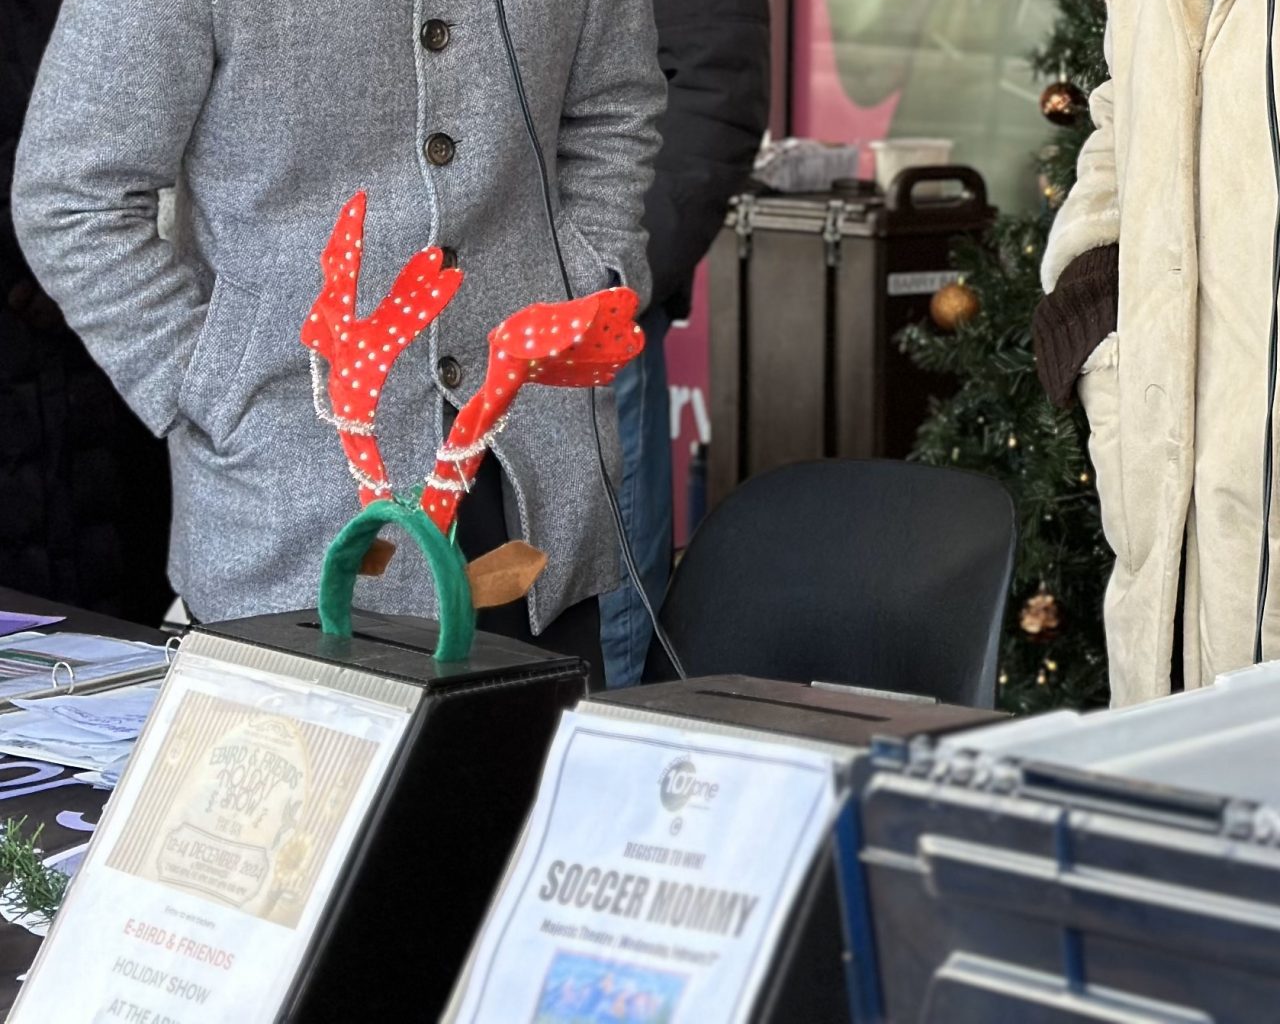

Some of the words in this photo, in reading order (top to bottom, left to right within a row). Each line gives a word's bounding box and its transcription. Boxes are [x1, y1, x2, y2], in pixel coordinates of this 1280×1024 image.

[623, 841, 669, 867] REGISTER
[538, 859, 650, 920] SOCCER
[645, 879, 760, 940] MOMMY
[165, 933, 176, 950] &
[175, 936, 236, 971] FRIENDS
[112, 957, 168, 989] HOLIDAY
[166, 975, 212, 1006] SHOW
